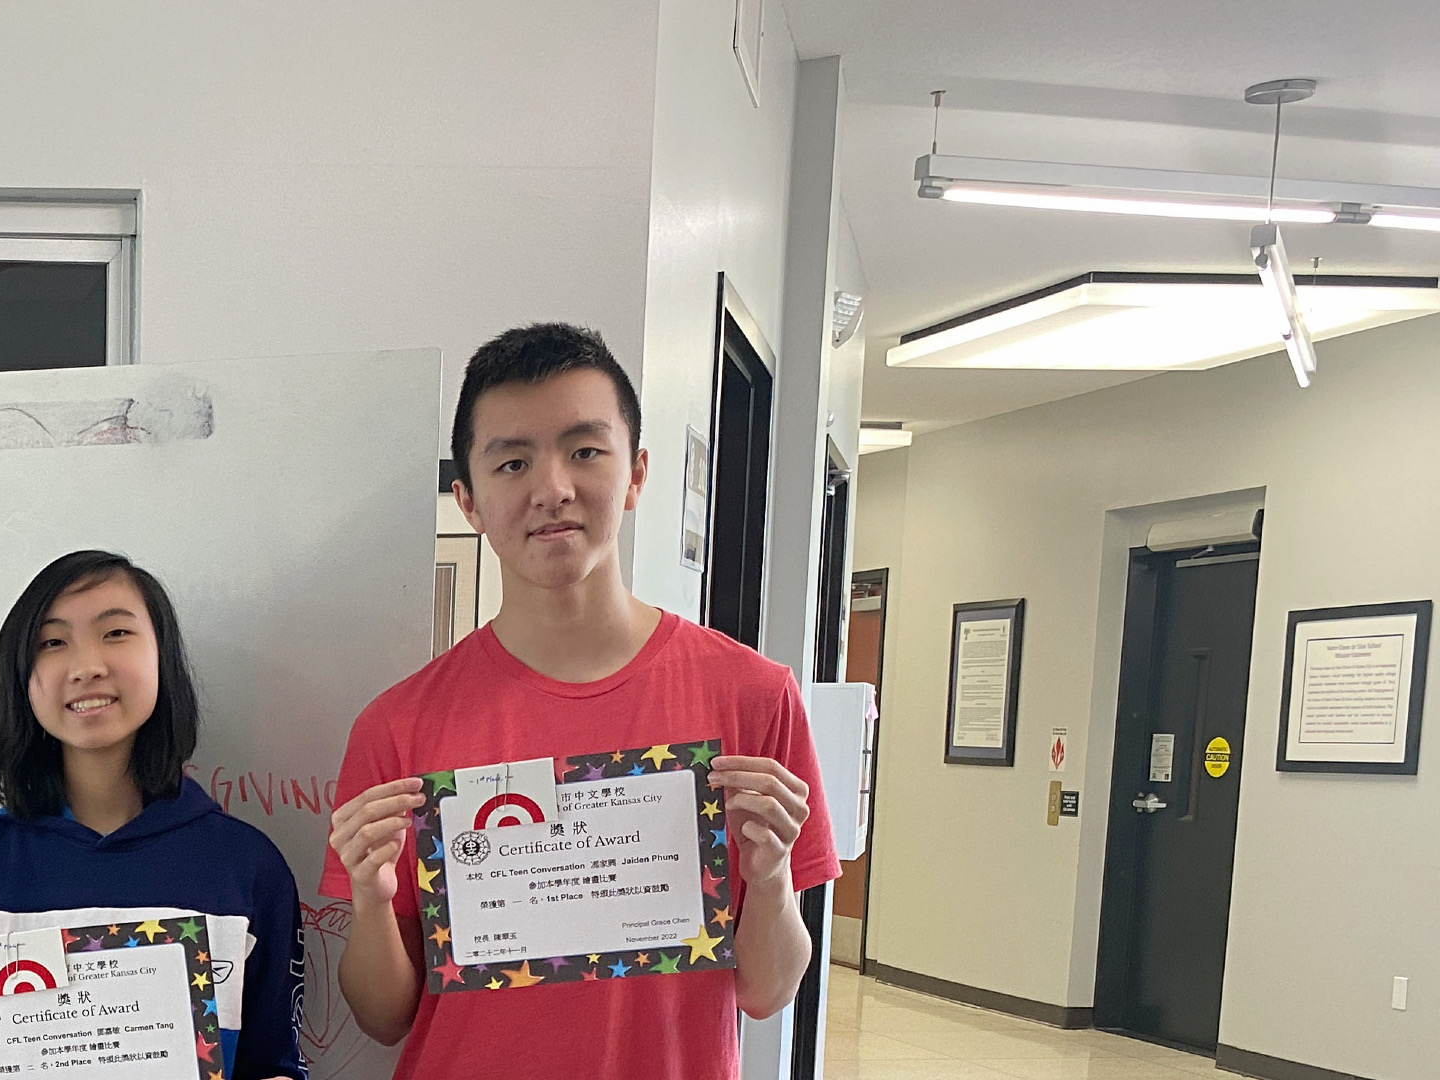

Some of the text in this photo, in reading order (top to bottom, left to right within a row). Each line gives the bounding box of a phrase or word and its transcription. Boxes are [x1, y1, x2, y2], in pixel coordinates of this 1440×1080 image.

[563, 803, 573, 813] of
[574, 801, 608, 811] Greater
[610, 798, 641, 808] Kansas
[643, 794, 663, 805] City
[499, 840, 571, 857] Certificate
[576, 837, 591, 849] of
[594, 831, 641, 847] Award
[490, 870, 507, 879] CFL
[509, 868, 529, 877] Teen
[530, 863, 585, 875] Conversation
[622, 856, 649, 866] Jaiden
[652, 853, 679, 864] Phung
[546, 894, 559, 903] 1st
[561, 892, 583, 901] Place
[622, 917, 690, 930] Principal Grace Chen
[625, 933, 677, 943] November 2022
[68, 966, 157, 982] of Greater Kansas City
[12, 1008, 79, 1025] Certificate
[82, 1006, 97, 1017] of
[98, 1001, 140, 1016] Award
[7, 1037, 22, 1045] CFL
[24, 1035, 41, 1043] Teen
[43, 1030, 93, 1041] Conversation
[124, 1024, 154, 1033] Carmen
[156, 1022, 174, 1031] Tang
[55, 1059, 70, 1068] 2nd
[71, 1058, 92, 1067] Place
